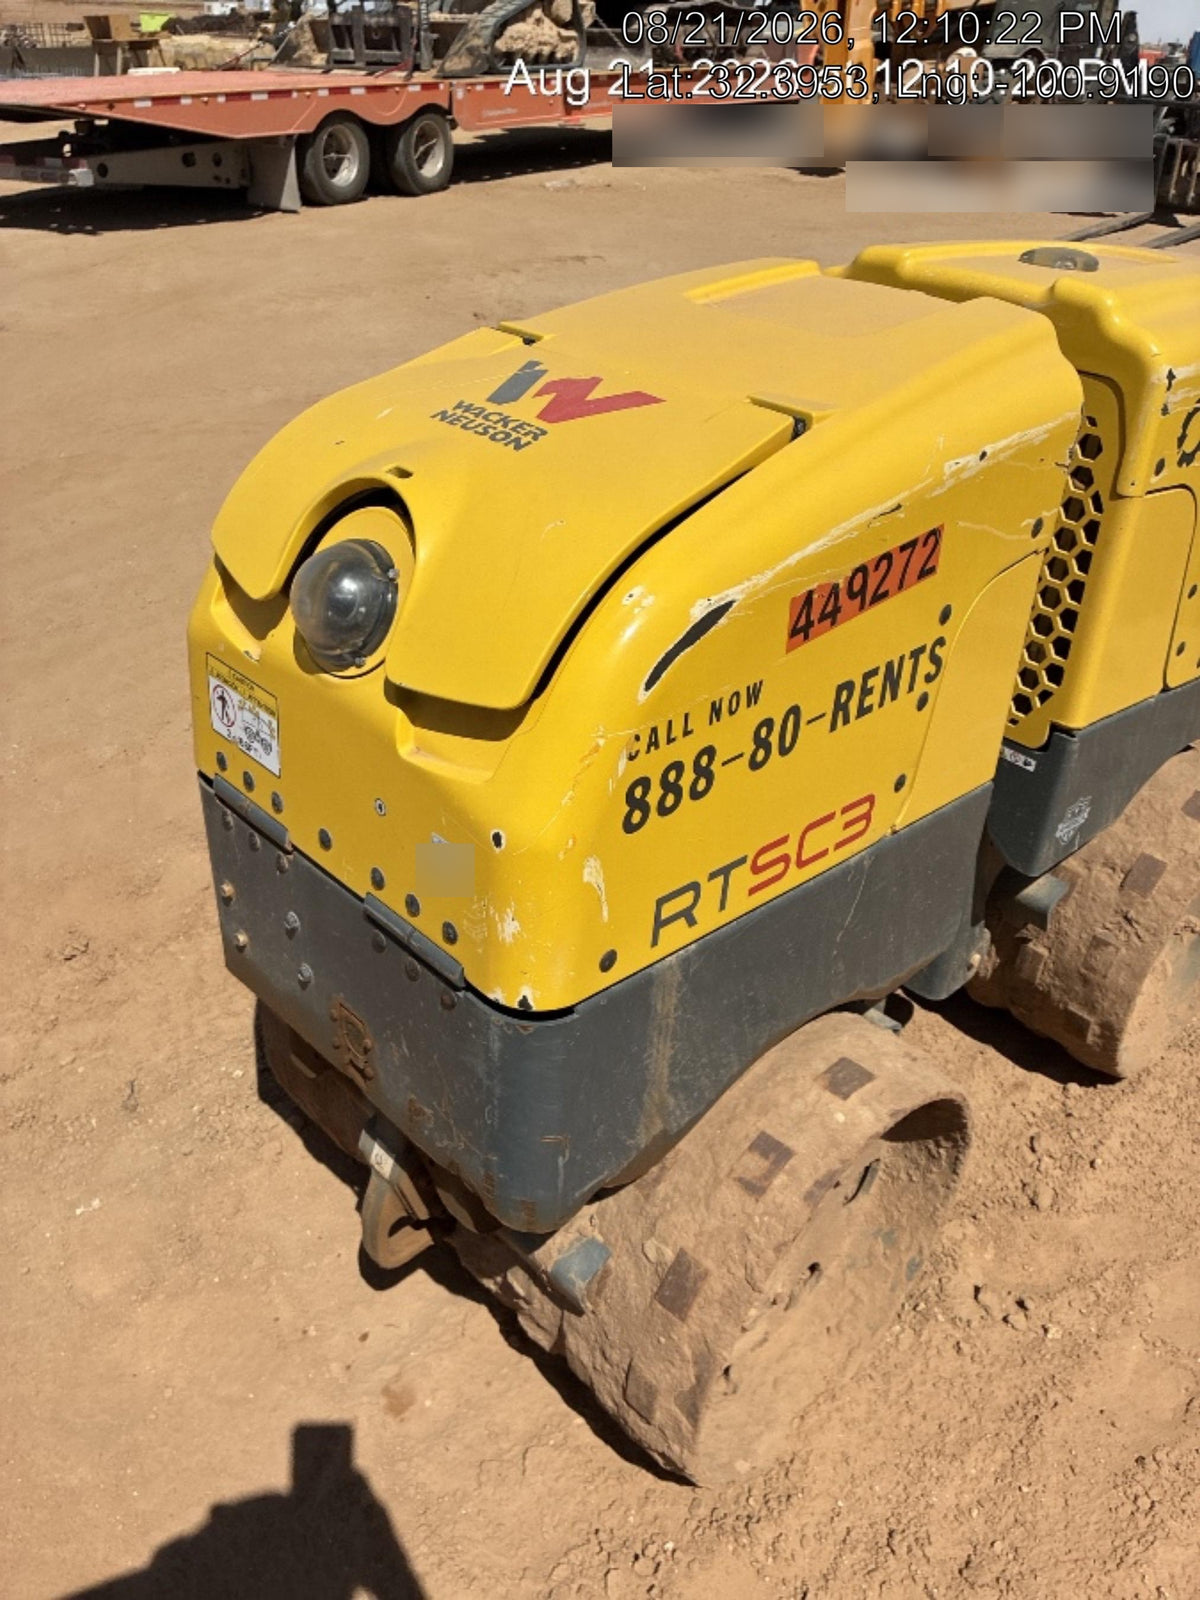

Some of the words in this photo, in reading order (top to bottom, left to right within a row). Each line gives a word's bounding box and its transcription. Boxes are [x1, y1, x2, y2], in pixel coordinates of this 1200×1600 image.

[430, 409, 532, 451] NEUSON
[452, 399, 548, 441] WACKER
[789, 527, 942, 642] 449272
[622, 636, 947, 834] 888-80-RENTS
[709, 679, 763, 725] NOW
[651, 794, 875, 948] RTSC3
